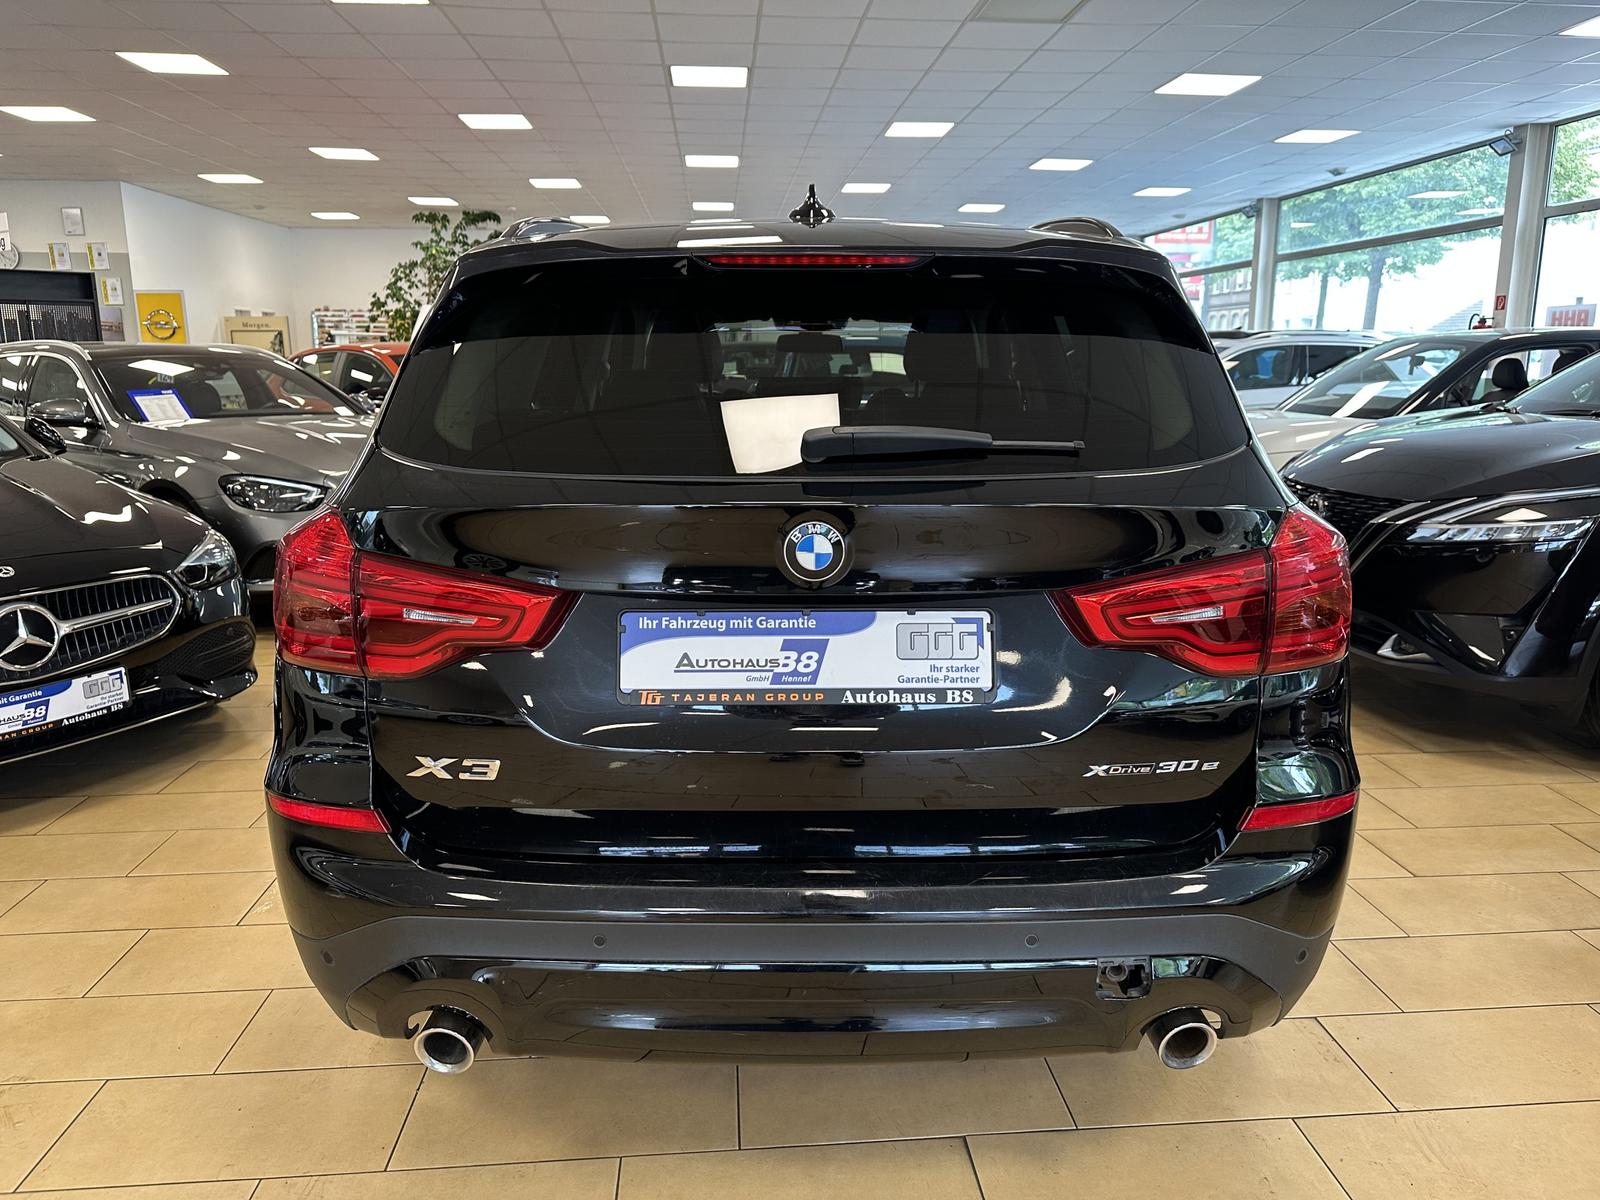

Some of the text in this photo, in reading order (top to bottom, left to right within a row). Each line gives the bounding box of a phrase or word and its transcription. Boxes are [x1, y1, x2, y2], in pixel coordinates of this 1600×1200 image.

[790, 524, 840, 543] BMW
[639, 616, 816, 631] Ihr Fahrzeug mit Garantie
[929, 664, 980, 673] Ihr starker
[897, 675, 980, 684] Garantie-Partner
[9, 690, 42, 703] Garantie
[672, 693, 755, 702] TAJERAN
[764, 693, 825, 702] GROUP
[841, 690, 974, 704] Autohaus B8
[62, 703, 124, 726] Autohaus B8
[22, 723, 54, 735] GROUP
[406, 756, 500, 780] X3
